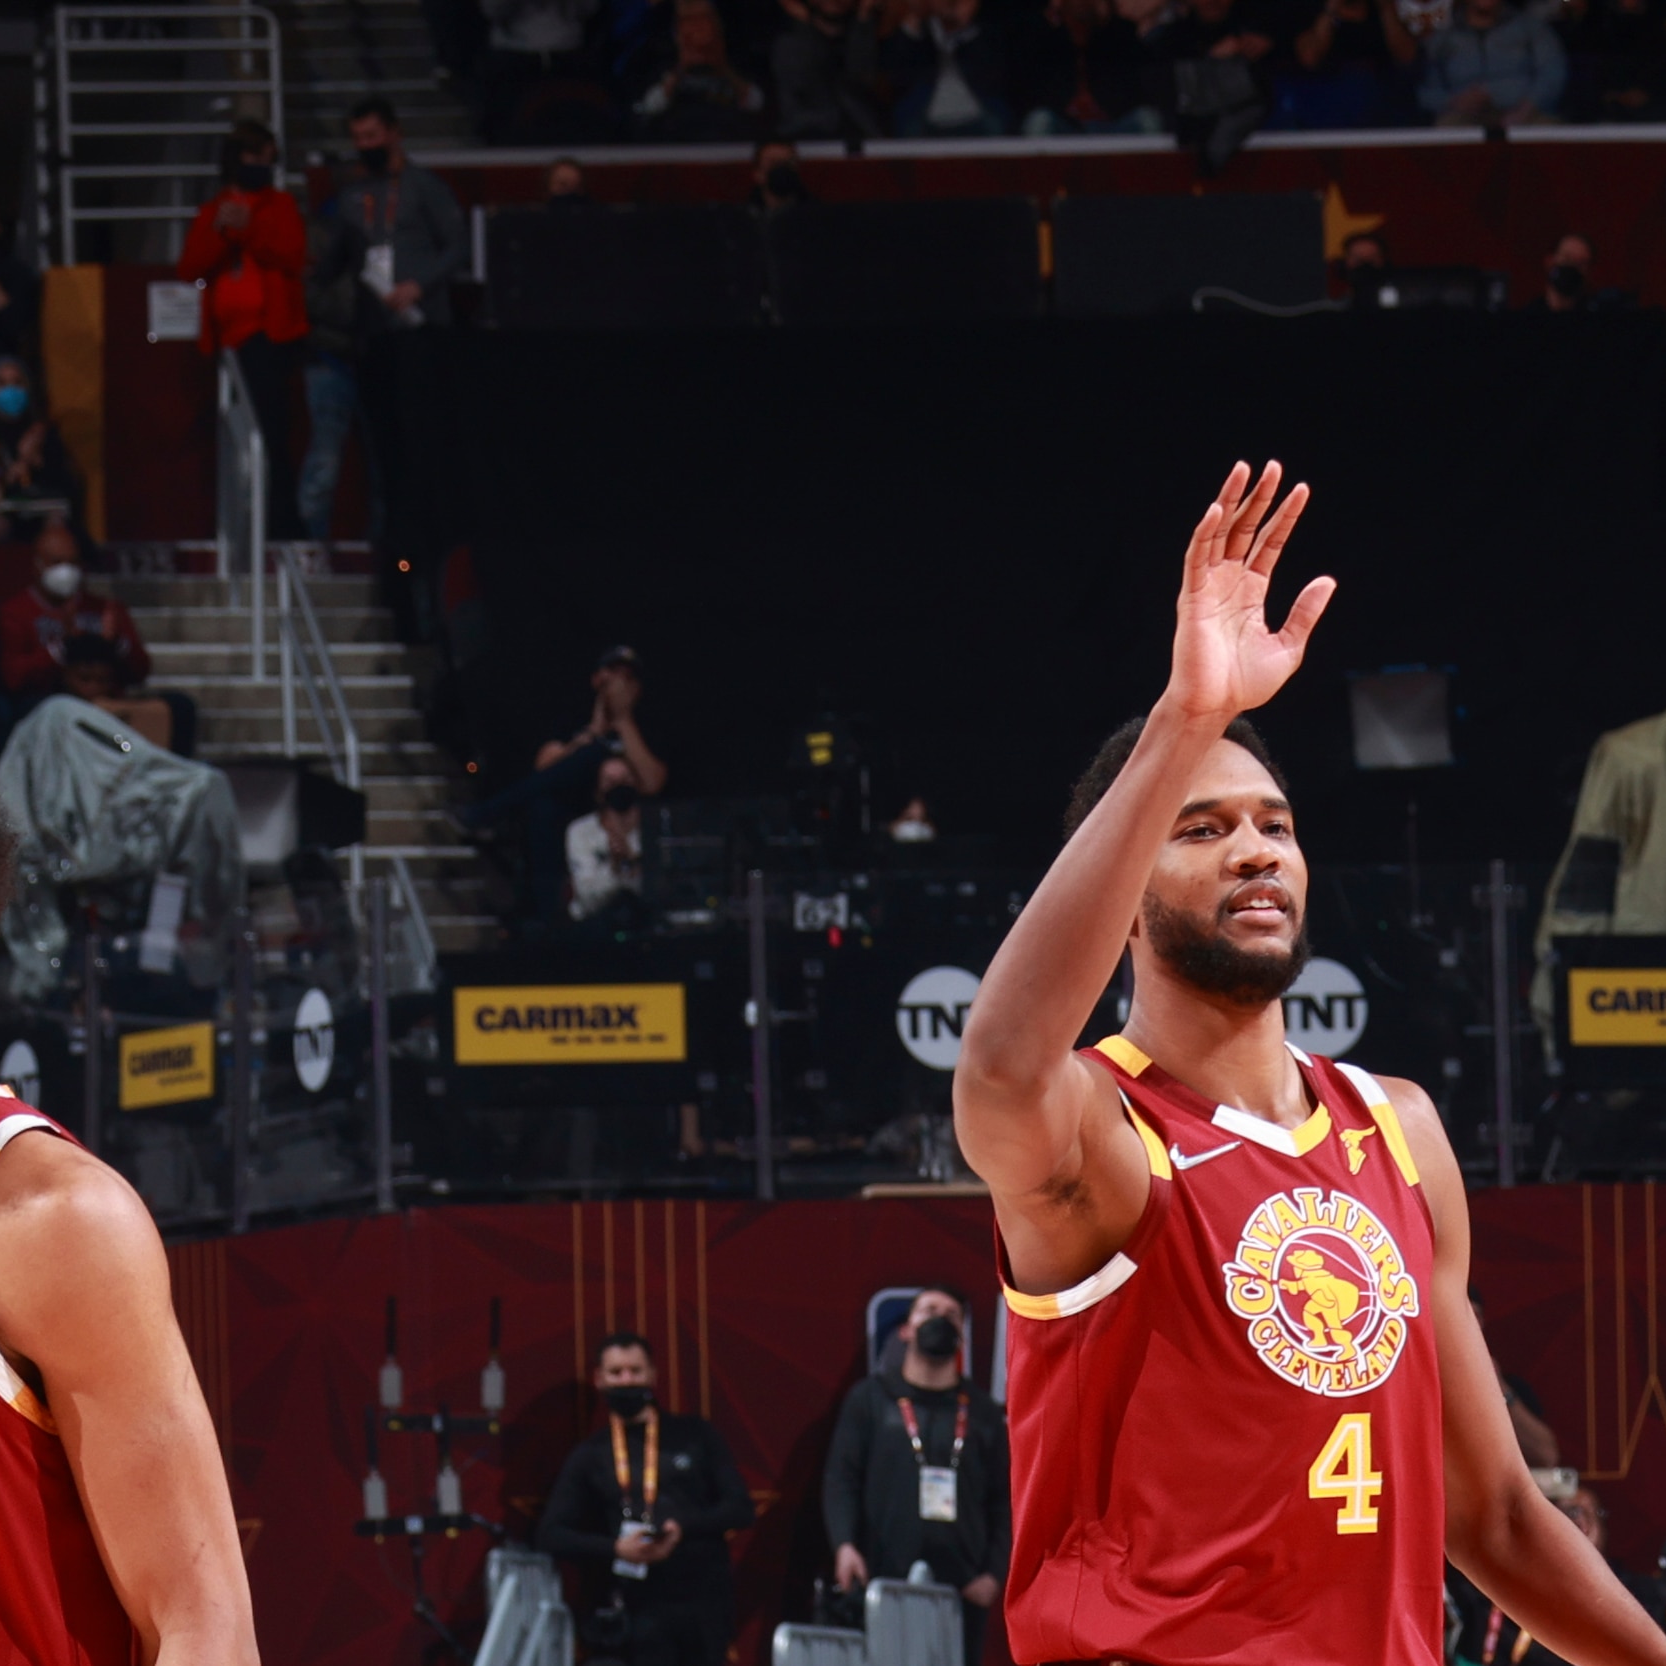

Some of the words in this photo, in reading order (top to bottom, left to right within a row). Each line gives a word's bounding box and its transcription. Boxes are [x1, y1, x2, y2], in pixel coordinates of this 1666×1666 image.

[898, 1003, 974, 1040] TN
[1223, 1188, 1419, 1318] CAVALIERS
[1247, 1316, 1406, 1397] CLEVELAND
[1308, 1412, 1383, 1535] 4
